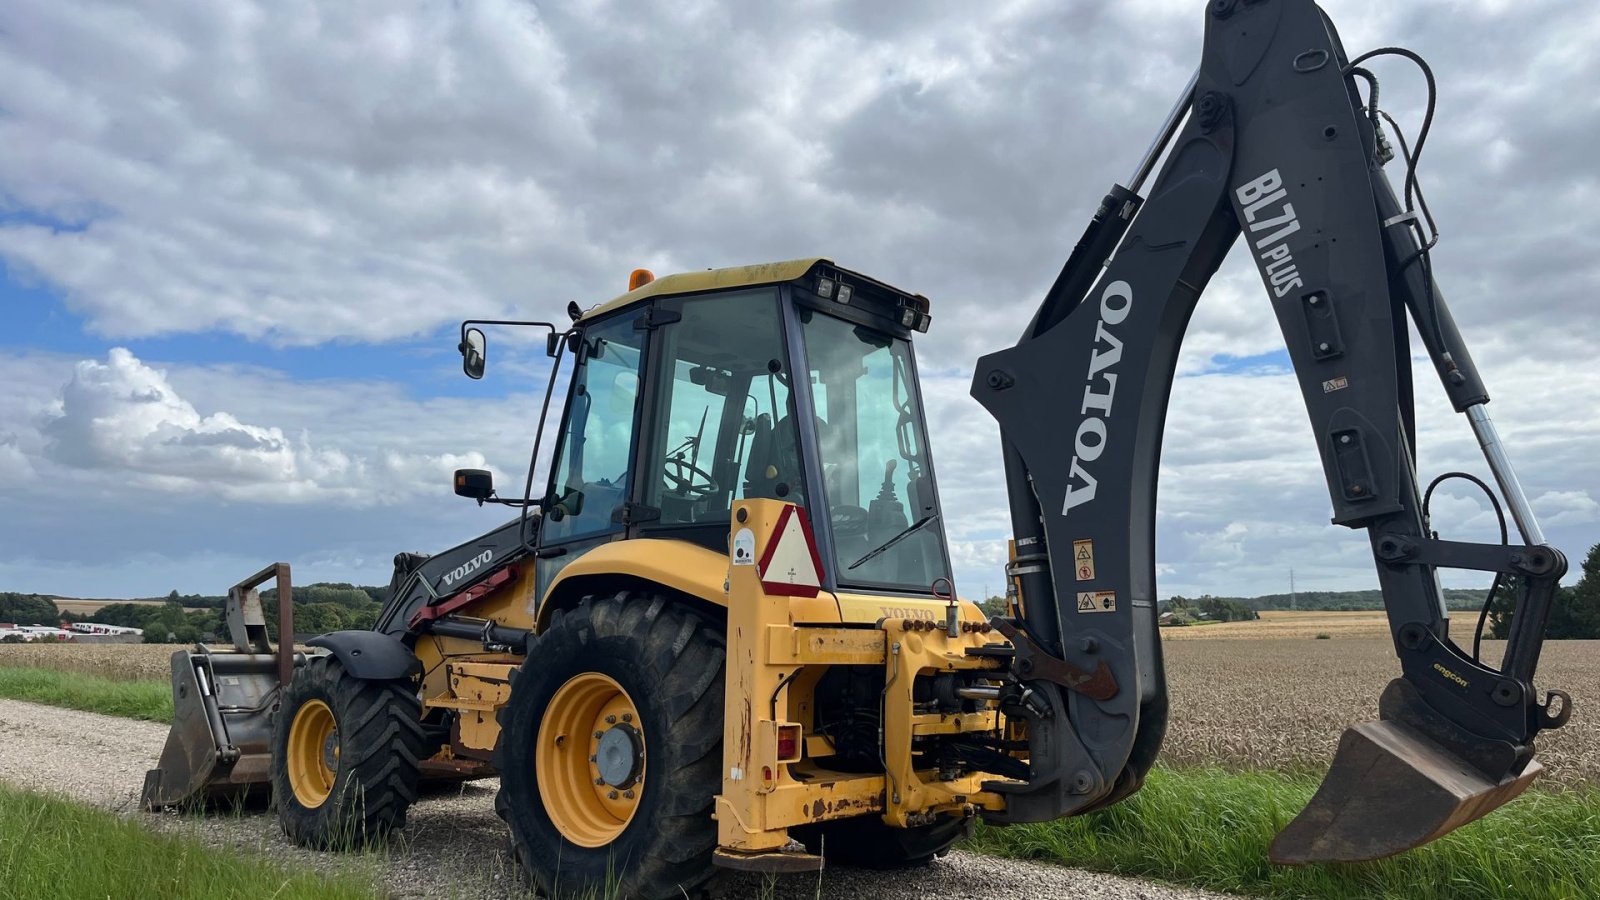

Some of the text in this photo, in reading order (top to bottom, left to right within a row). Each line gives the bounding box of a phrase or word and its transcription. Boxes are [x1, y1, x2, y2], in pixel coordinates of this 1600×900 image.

[1235, 168, 1304, 298] BL71 PLUS
[1061, 279, 1133, 516] VOLVO
[442, 549, 493, 586] VOLVO
[880, 606, 936, 621] VOLVO
[1433, 663, 1468, 687] engcon
